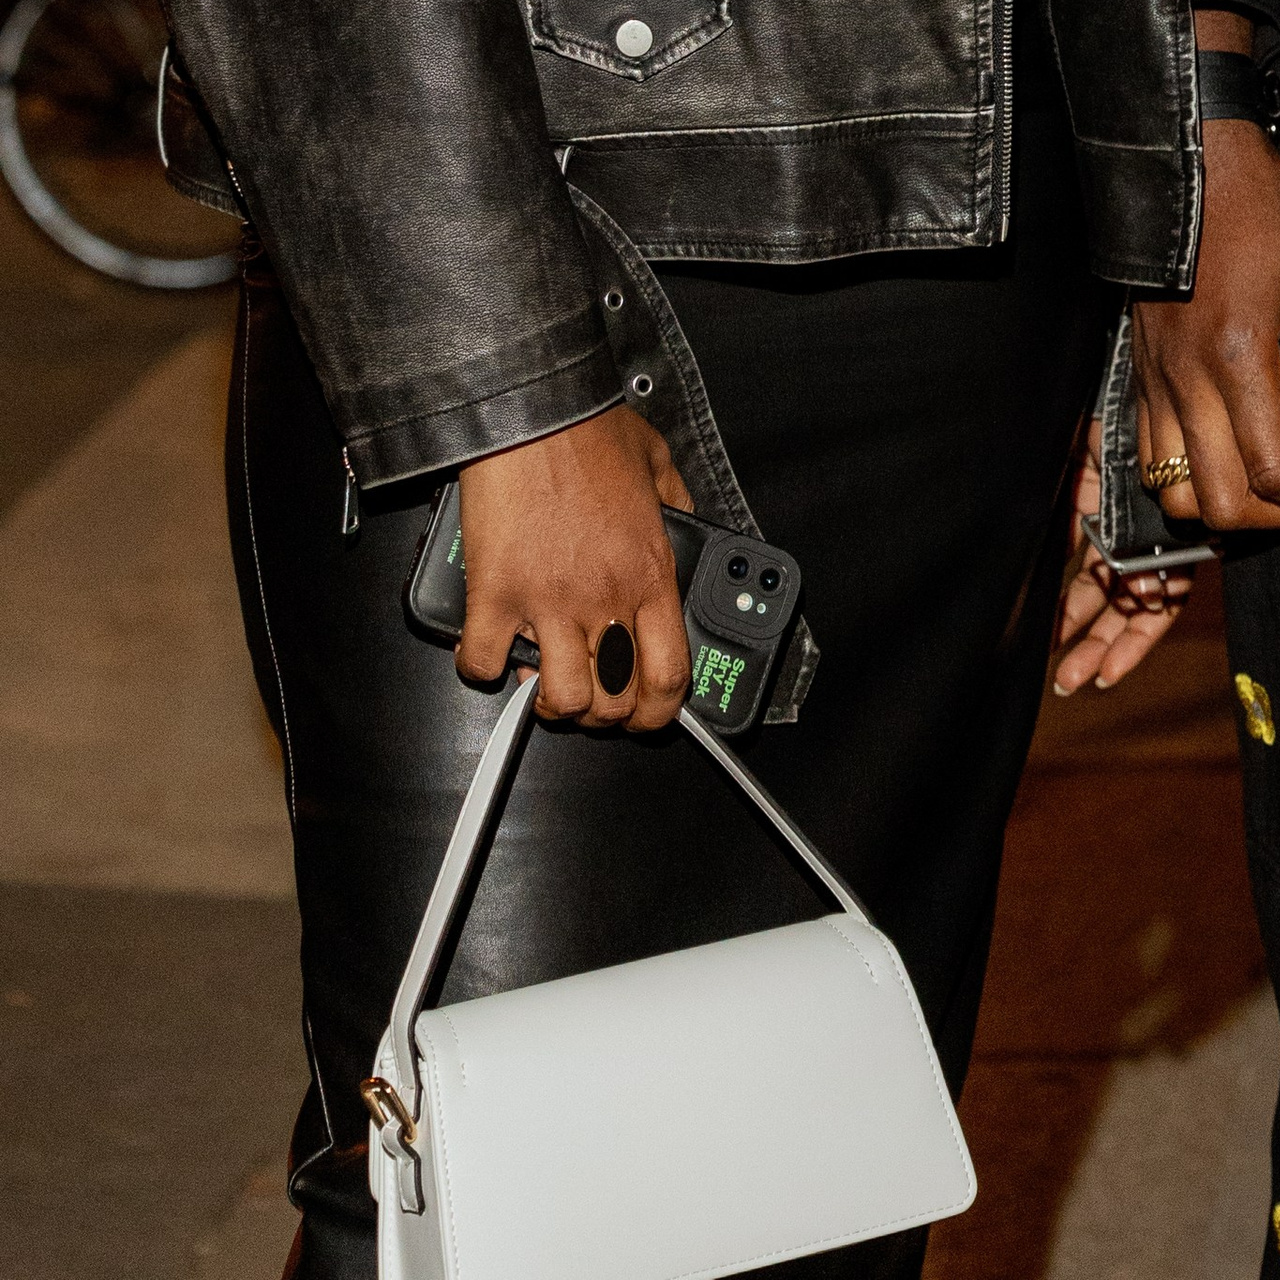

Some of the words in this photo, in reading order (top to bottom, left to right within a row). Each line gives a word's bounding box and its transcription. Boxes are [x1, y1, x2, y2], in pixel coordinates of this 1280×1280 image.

[695, 648, 722, 698] Black
[713, 654, 732, 686] dry
[719, 658, 745, 713] Super
